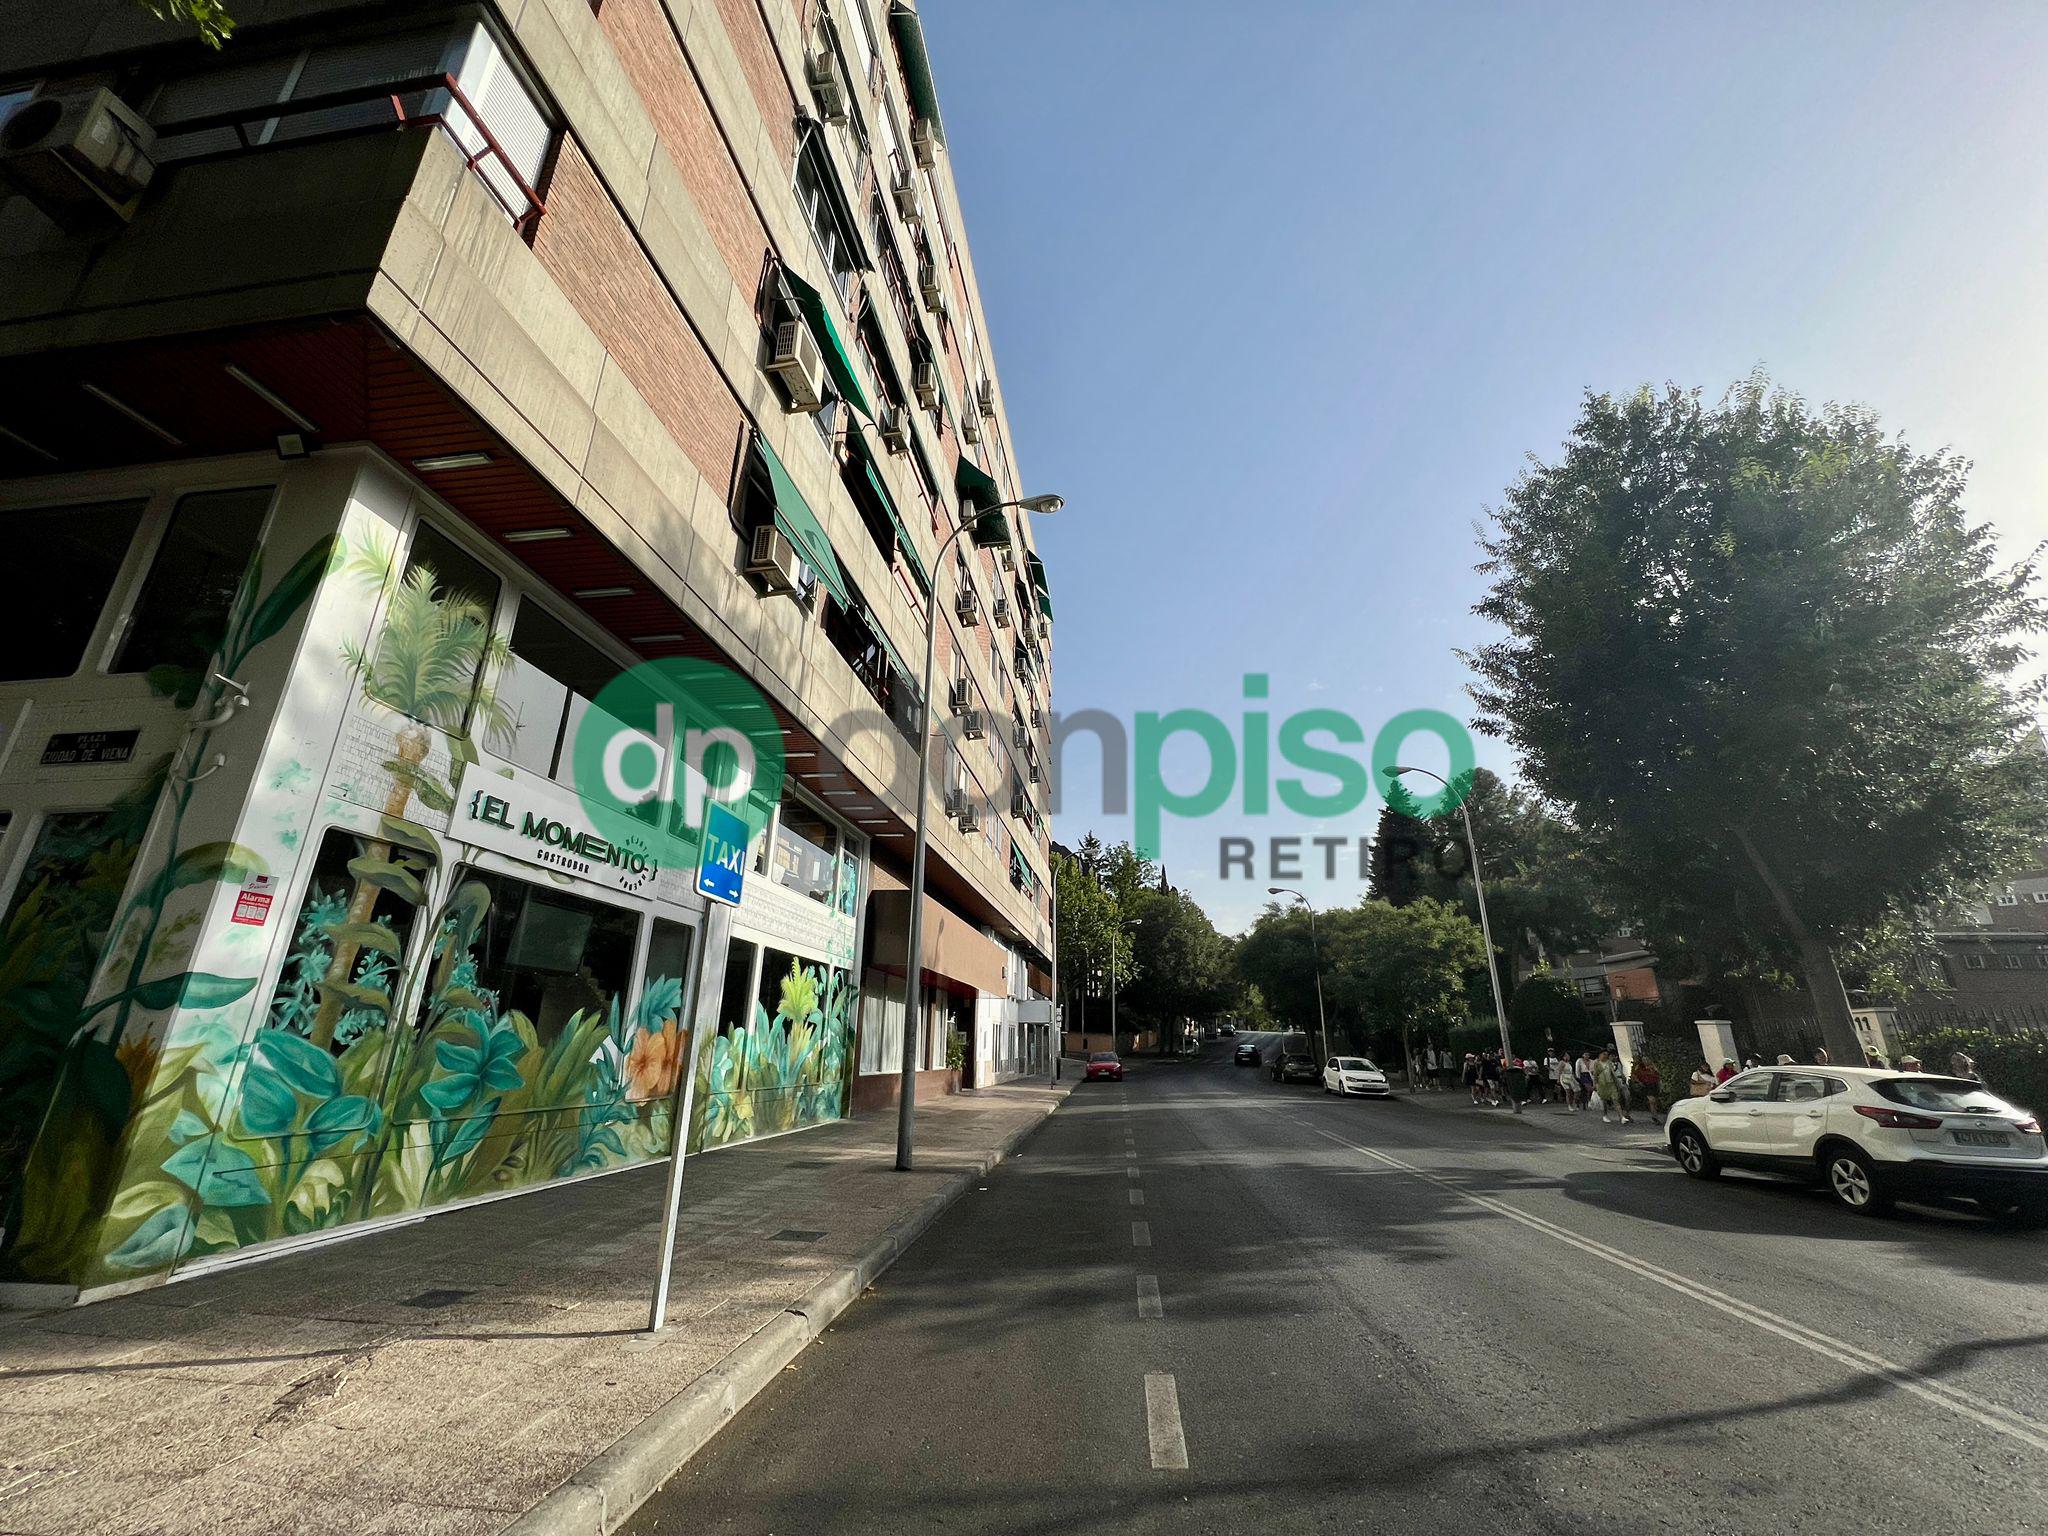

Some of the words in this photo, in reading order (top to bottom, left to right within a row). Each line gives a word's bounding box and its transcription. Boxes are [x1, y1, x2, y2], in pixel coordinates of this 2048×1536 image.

[42, 750, 77, 763] CIUDAD
[81, 749, 95, 762] DE
[101, 748, 128, 760] VIENA
[537, 849, 590, 874] GASTROBAR
[707, 834, 746, 876] TAXI
[241, 893, 270, 904] Alarma
[1854, 1016, 1871, 1031] 11
